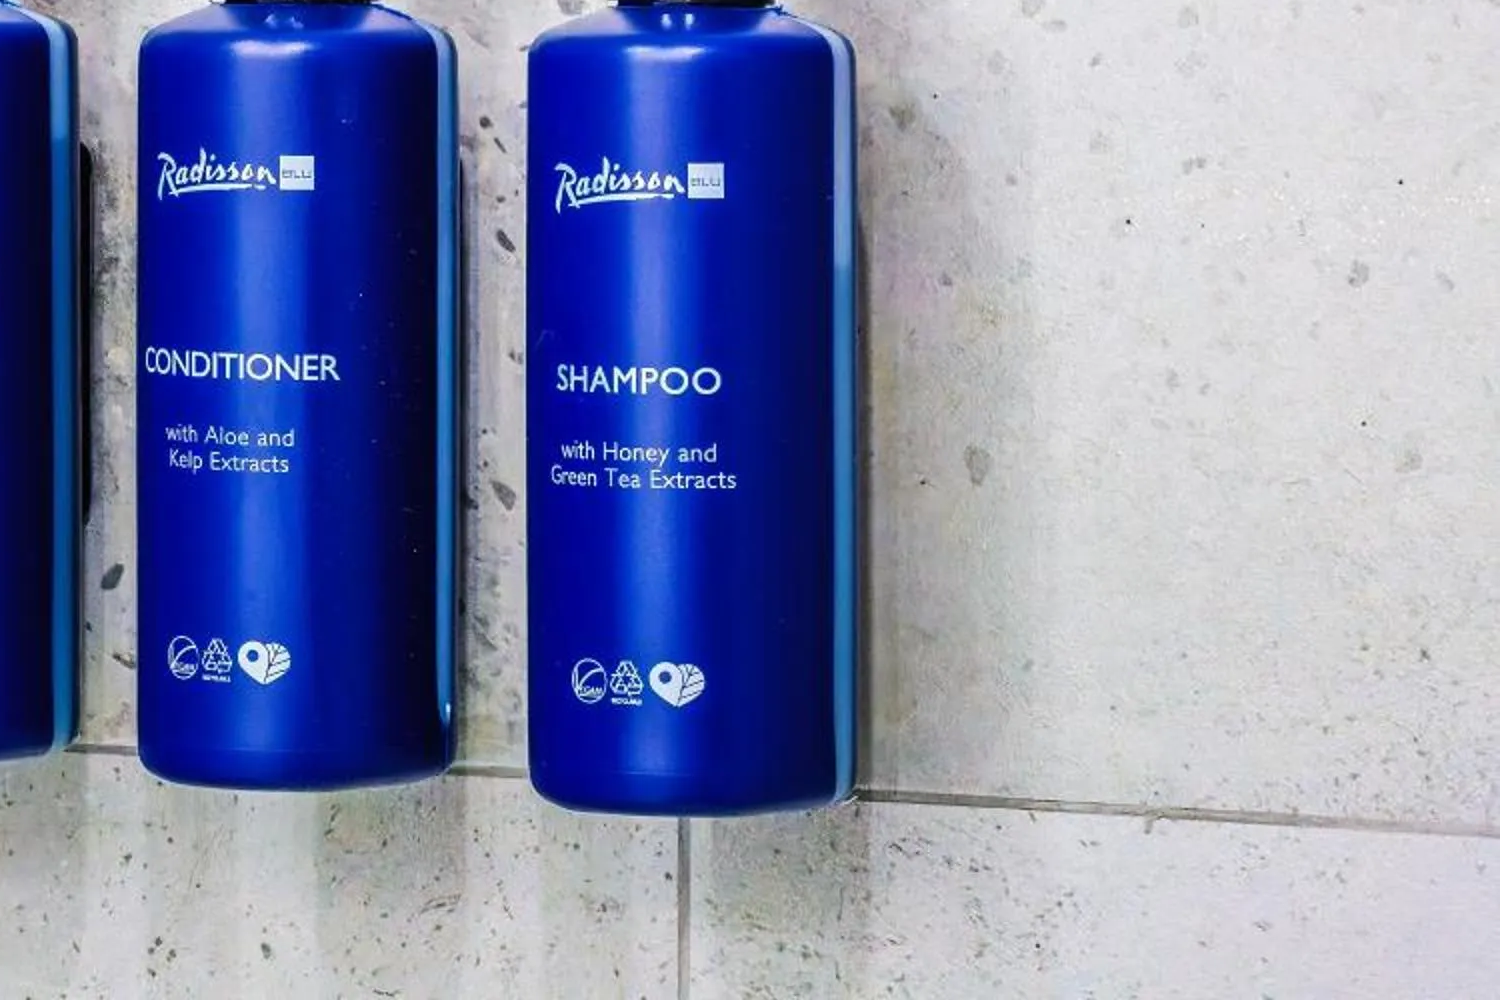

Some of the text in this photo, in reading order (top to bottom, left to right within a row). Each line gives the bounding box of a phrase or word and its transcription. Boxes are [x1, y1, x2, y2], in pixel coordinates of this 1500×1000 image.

[157, 147, 277, 200] Radisson
[554, 156, 685, 214] Radisson
[145, 346, 341, 381] CONDITIONER
[556, 363, 722, 395] SHAMPOO
[165, 423, 296, 447] with Aloe and
[169, 447, 289, 475] Kelp Extracts
[561, 440, 718, 468] with Honey and
[551, 464, 737, 490] Green Tea Extracts
